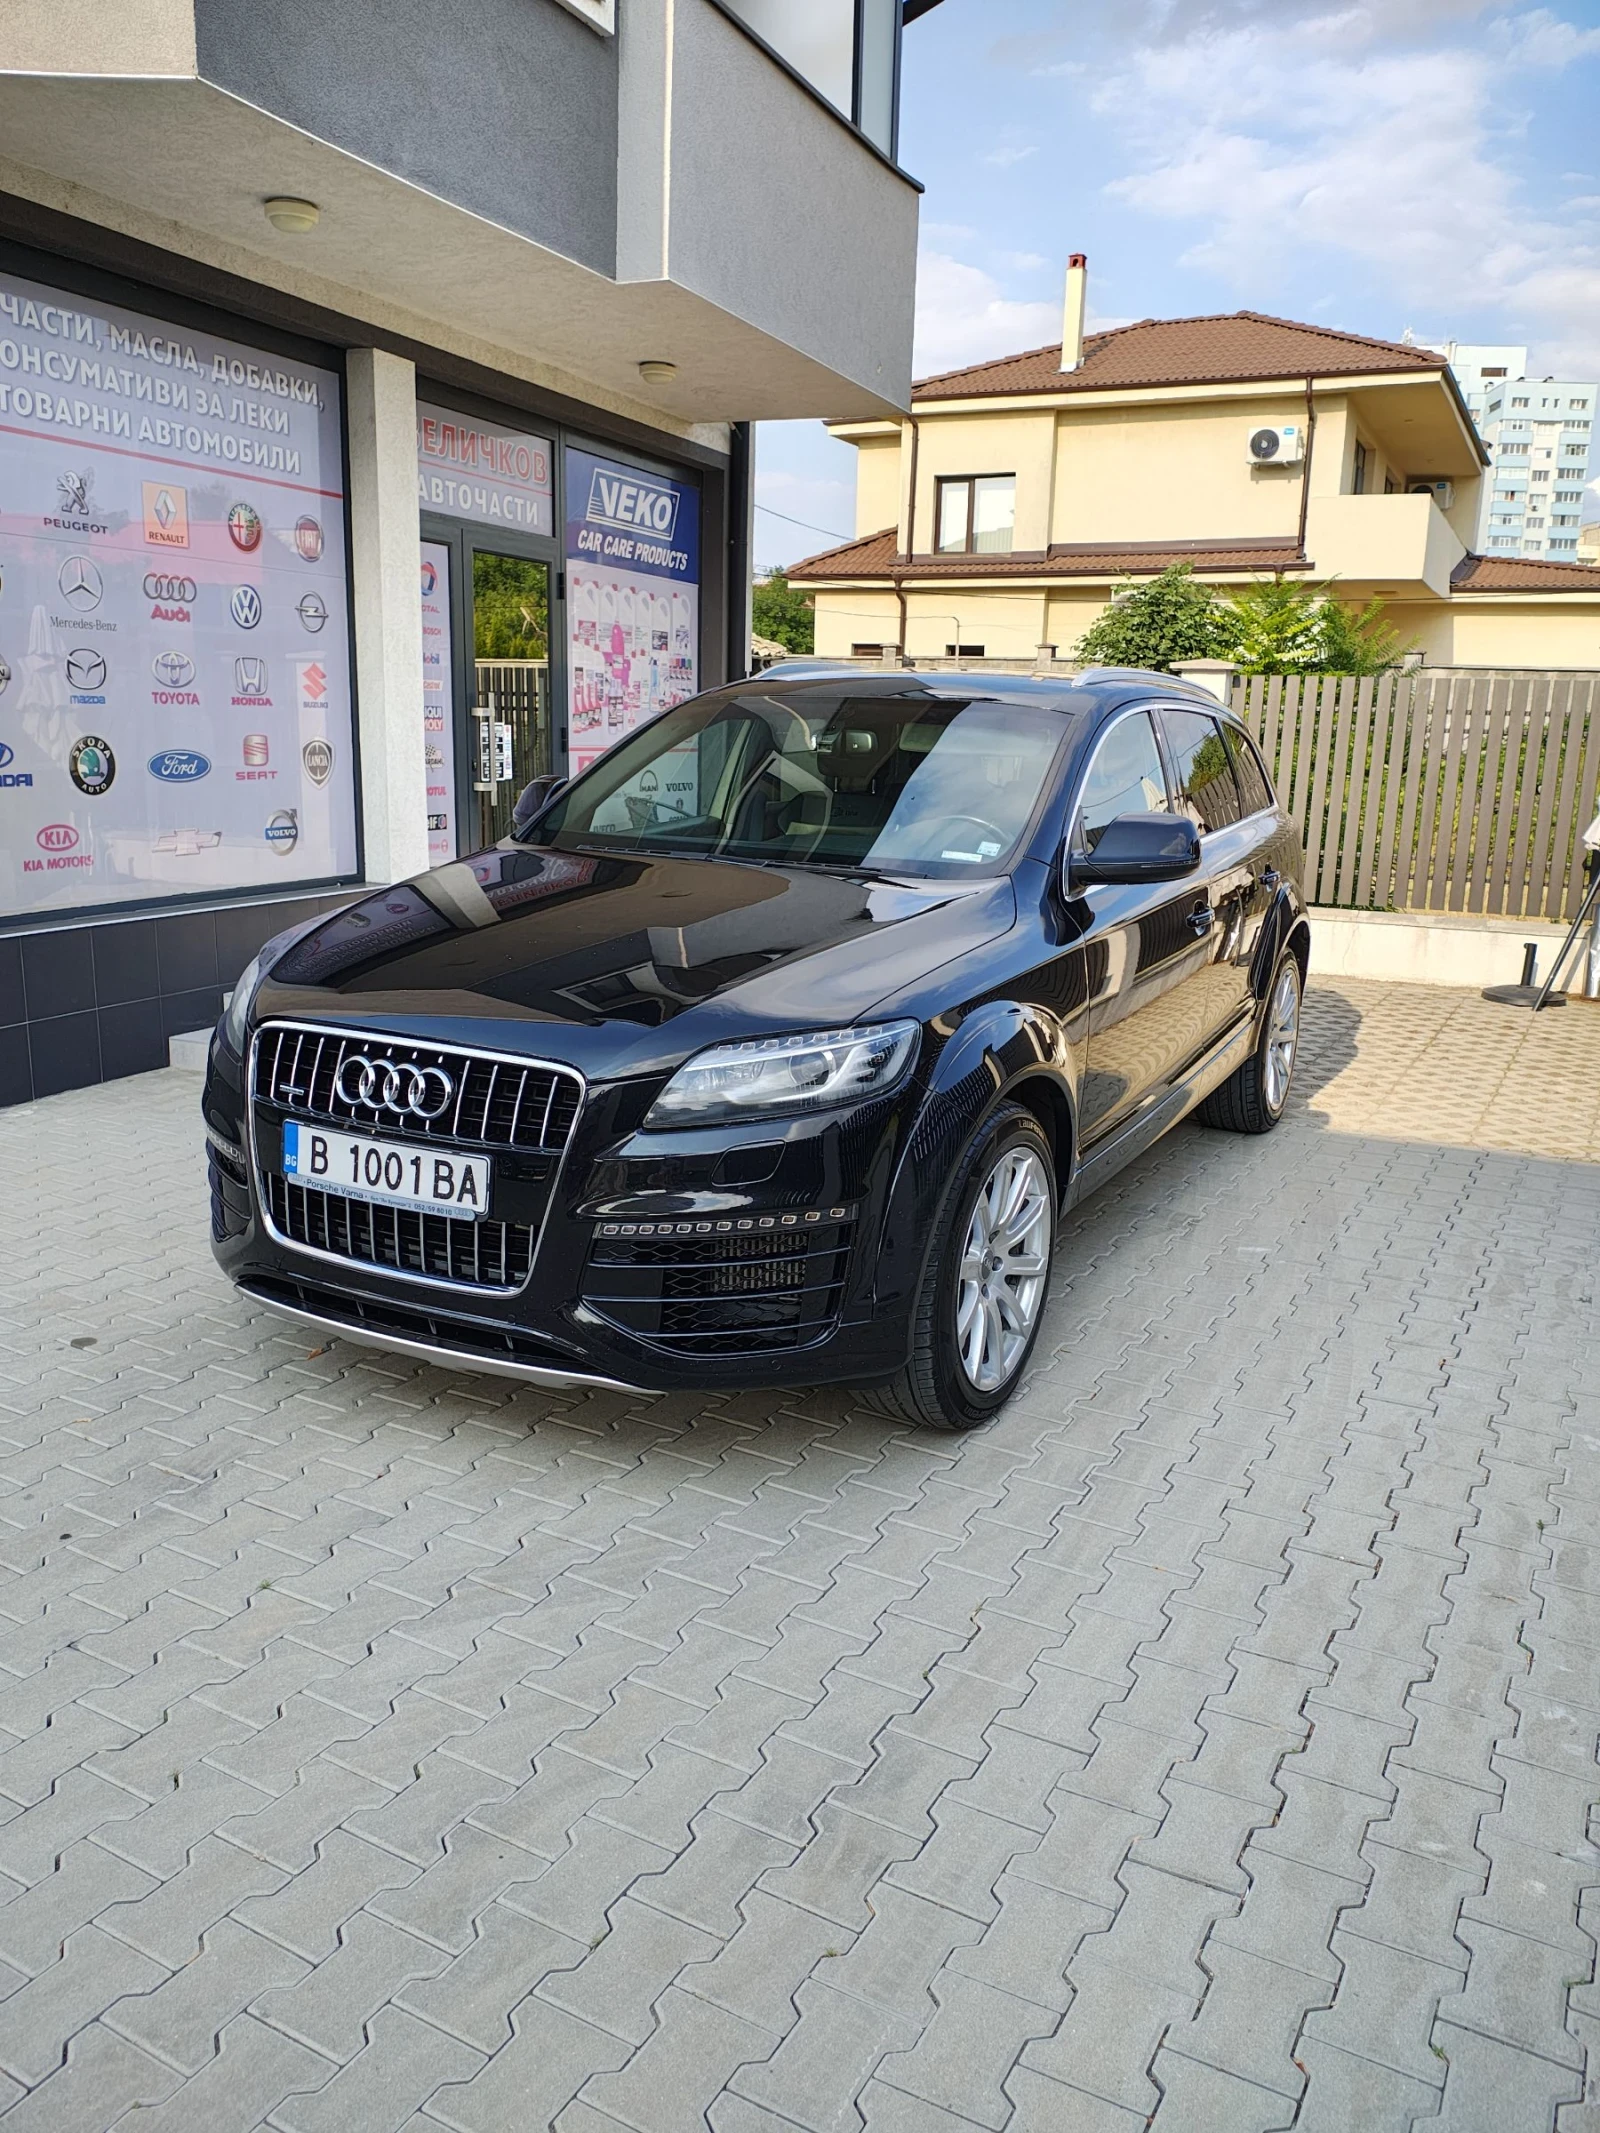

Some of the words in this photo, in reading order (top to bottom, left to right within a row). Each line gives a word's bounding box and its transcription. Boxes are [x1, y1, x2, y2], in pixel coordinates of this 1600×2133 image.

[110, 324, 206, 378] МАСЛА,
[211, 354, 325, 411] ДОБАВКИ,
[0, 339, 189, 410] ОНСУМАТИВИ
[196, 388, 225, 419] ЗА
[230, 397, 289, 436] ЛЕКИ
[0, 383, 131, 438] ТОВАРНИ
[138, 415, 300, 474] АВТОМОБИЛИ
[416, 416, 547, 484] ЕЛИЧКОВ
[418, 474, 538, 525] АВТОЧАСТИ
[599, 477, 673, 530] VEKO
[43, 517, 108, 534] PEUGEOT
[149, 531, 184, 544] RENAULT
[578, 529, 602, 553] CAR
[604, 535, 634, 559] CARE
[634, 542, 688, 571] PRODUCTS
[151, 604, 190, 622] Audi
[422, 604, 440, 614] OTAL
[50, 616, 117, 631] Mercedes-Benz
[151, 692, 200, 705] TOYOTA
[231, 697, 273, 706] HONDA
[303, 701, 328, 709] SUZUKI
[72, 737, 111, 758] SKODA
[161, 754, 198, 776] Ford
[235, 771, 278, 780] SEAT
[82, 783, 107, 793] AUTO
[665, 782, 694, 792] VOLVO
[45, 831, 72, 845] KIA
[267, 829, 296, 837] VOLVO
[23, 860, 44, 872] KIA
[47, 855, 94, 870] MOTORS
[285, 1154, 297, 1166] BG
[311, 1134, 328, 1175] B
[350, 1144, 421, 1195] 1001
[433, 1158, 478, 1205] BA
[306, 1178, 339, 1194] Porsche
